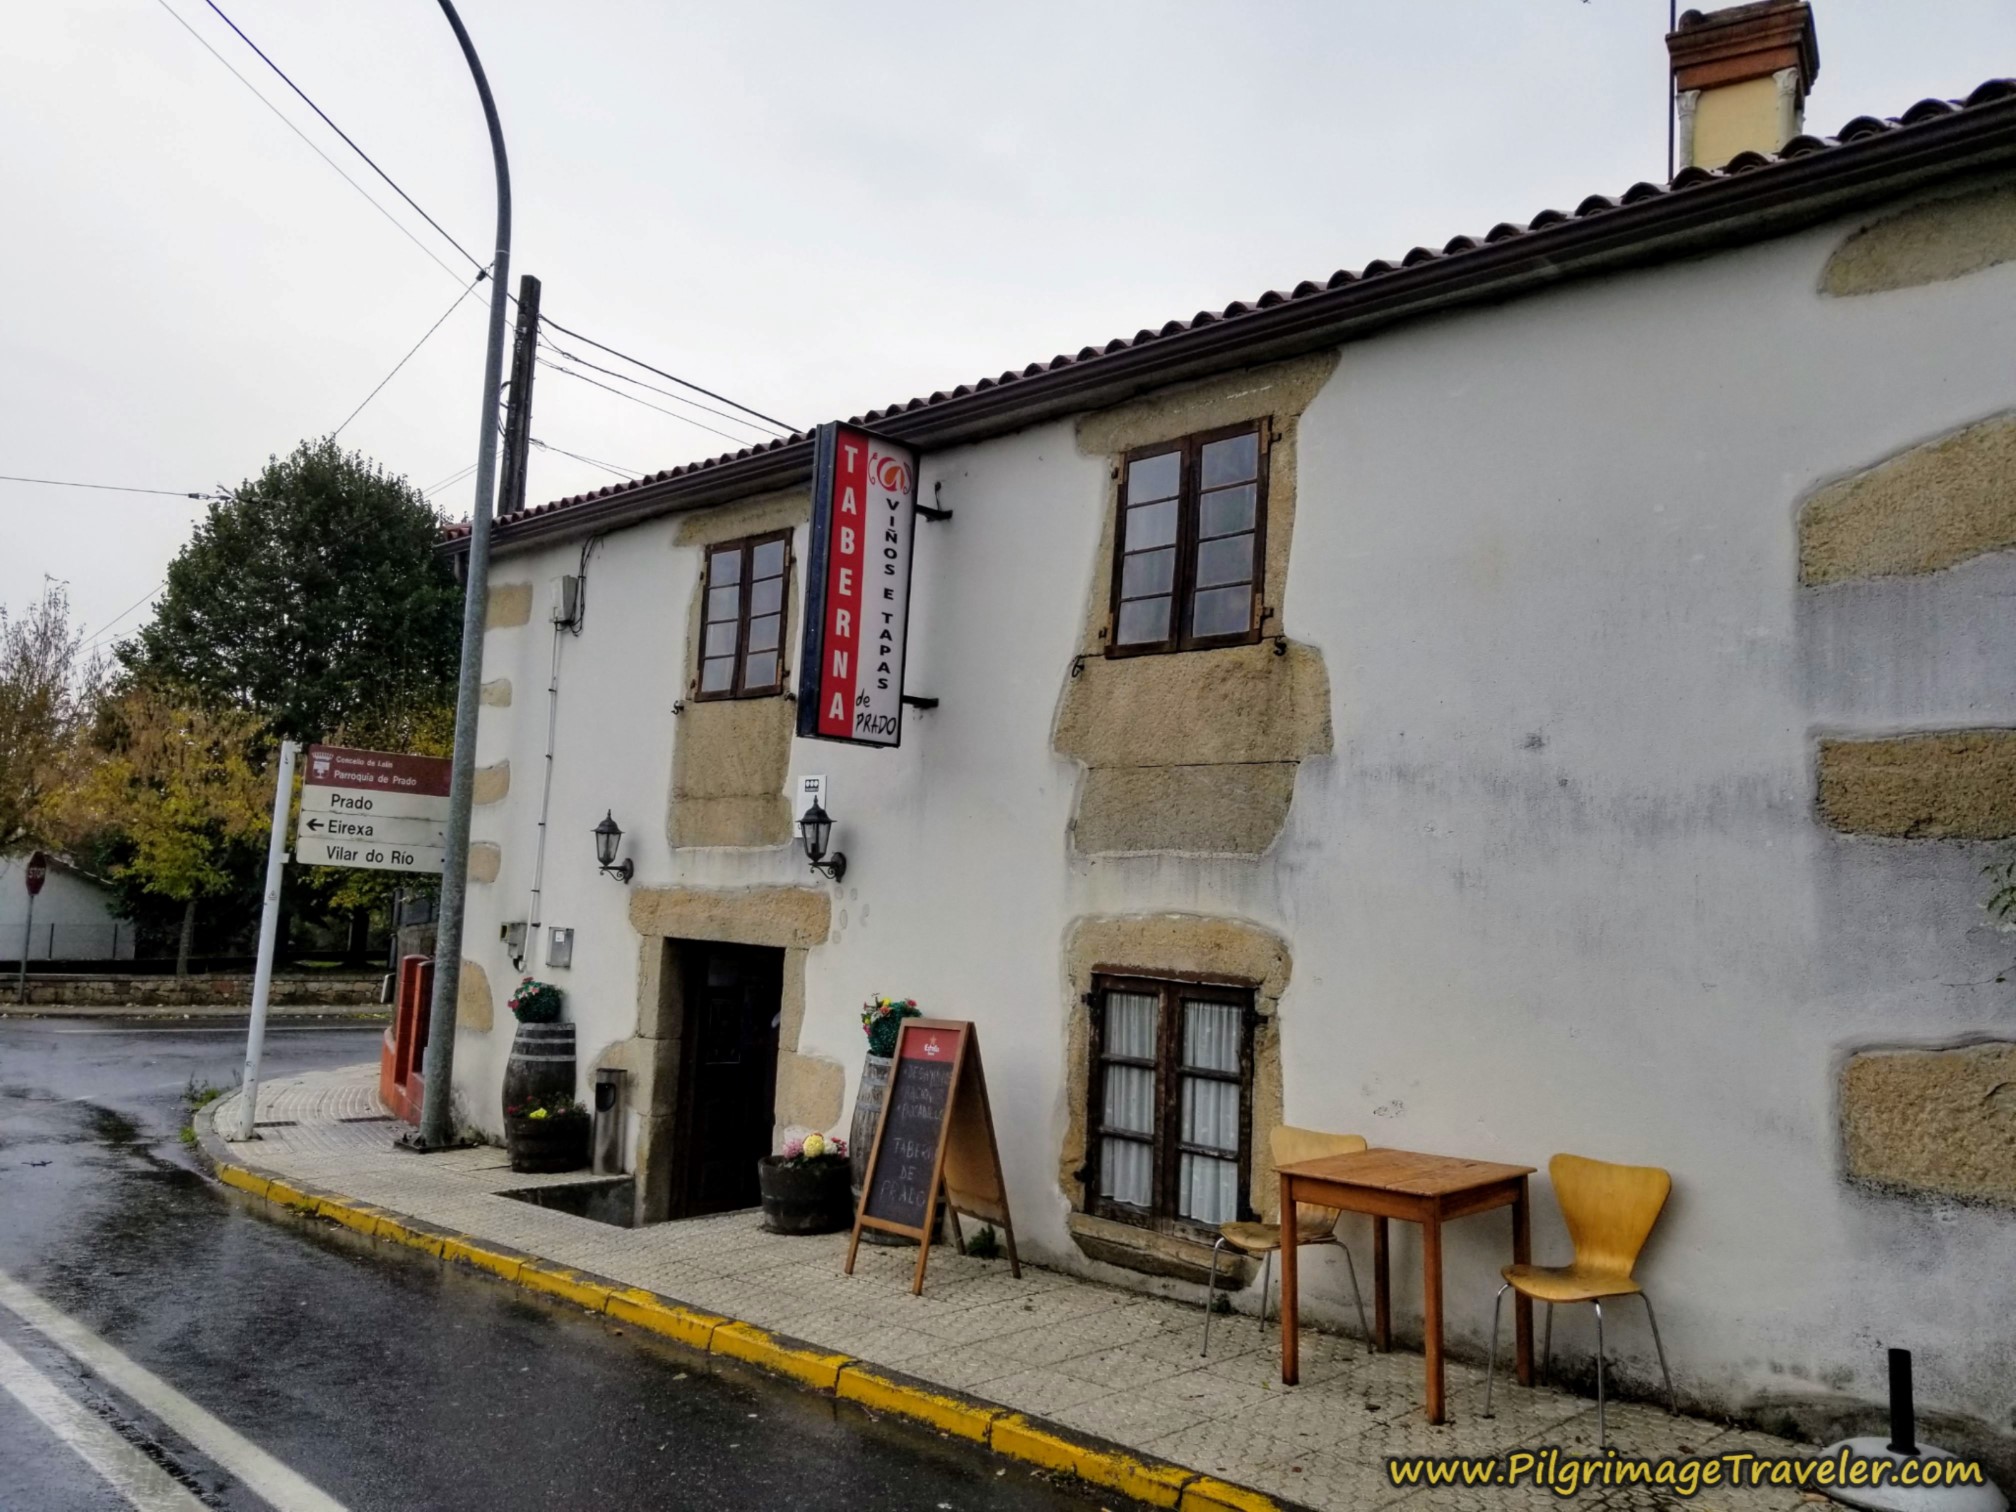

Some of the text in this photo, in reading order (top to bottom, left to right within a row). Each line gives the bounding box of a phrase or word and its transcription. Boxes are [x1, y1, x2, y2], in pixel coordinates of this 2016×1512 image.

[828, 445, 858, 721] TABERNA
[877, 498, 900, 690] VIÑOS E TAPAS
[855, 688, 871, 708] de
[855, 712, 897, 736] PRADO
[336, 755, 365, 765] Concello
[334, 770, 417, 786] Parroquia de Prado
[331, 794, 373, 810] Prado
[328, 819, 374, 836] Eirexa
[326, 845, 414, 865] Vilar do Río
[899, 1165, 917, 1181] DE
